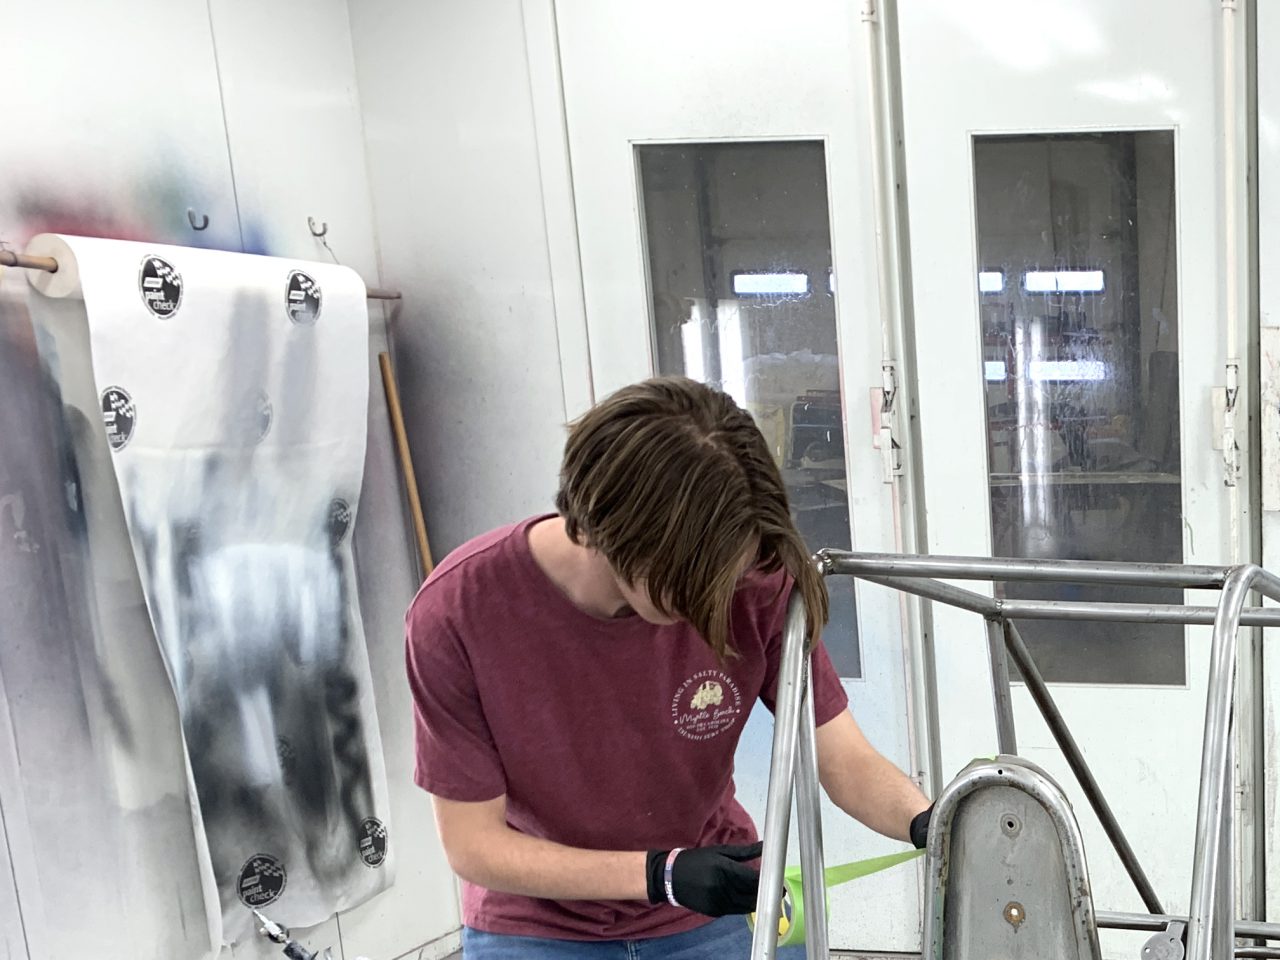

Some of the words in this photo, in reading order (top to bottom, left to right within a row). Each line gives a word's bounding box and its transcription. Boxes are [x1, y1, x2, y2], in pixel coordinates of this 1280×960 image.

[671, 687, 685, 717] LIVING
[683, 679, 693, 688] IN
[693, 670, 718, 679] SALTY
[719, 672, 742, 706] PARADISE
[679, 711, 710, 725] Myrtle
[242, 884, 263, 898] paint
[250, 889, 275, 903] check
